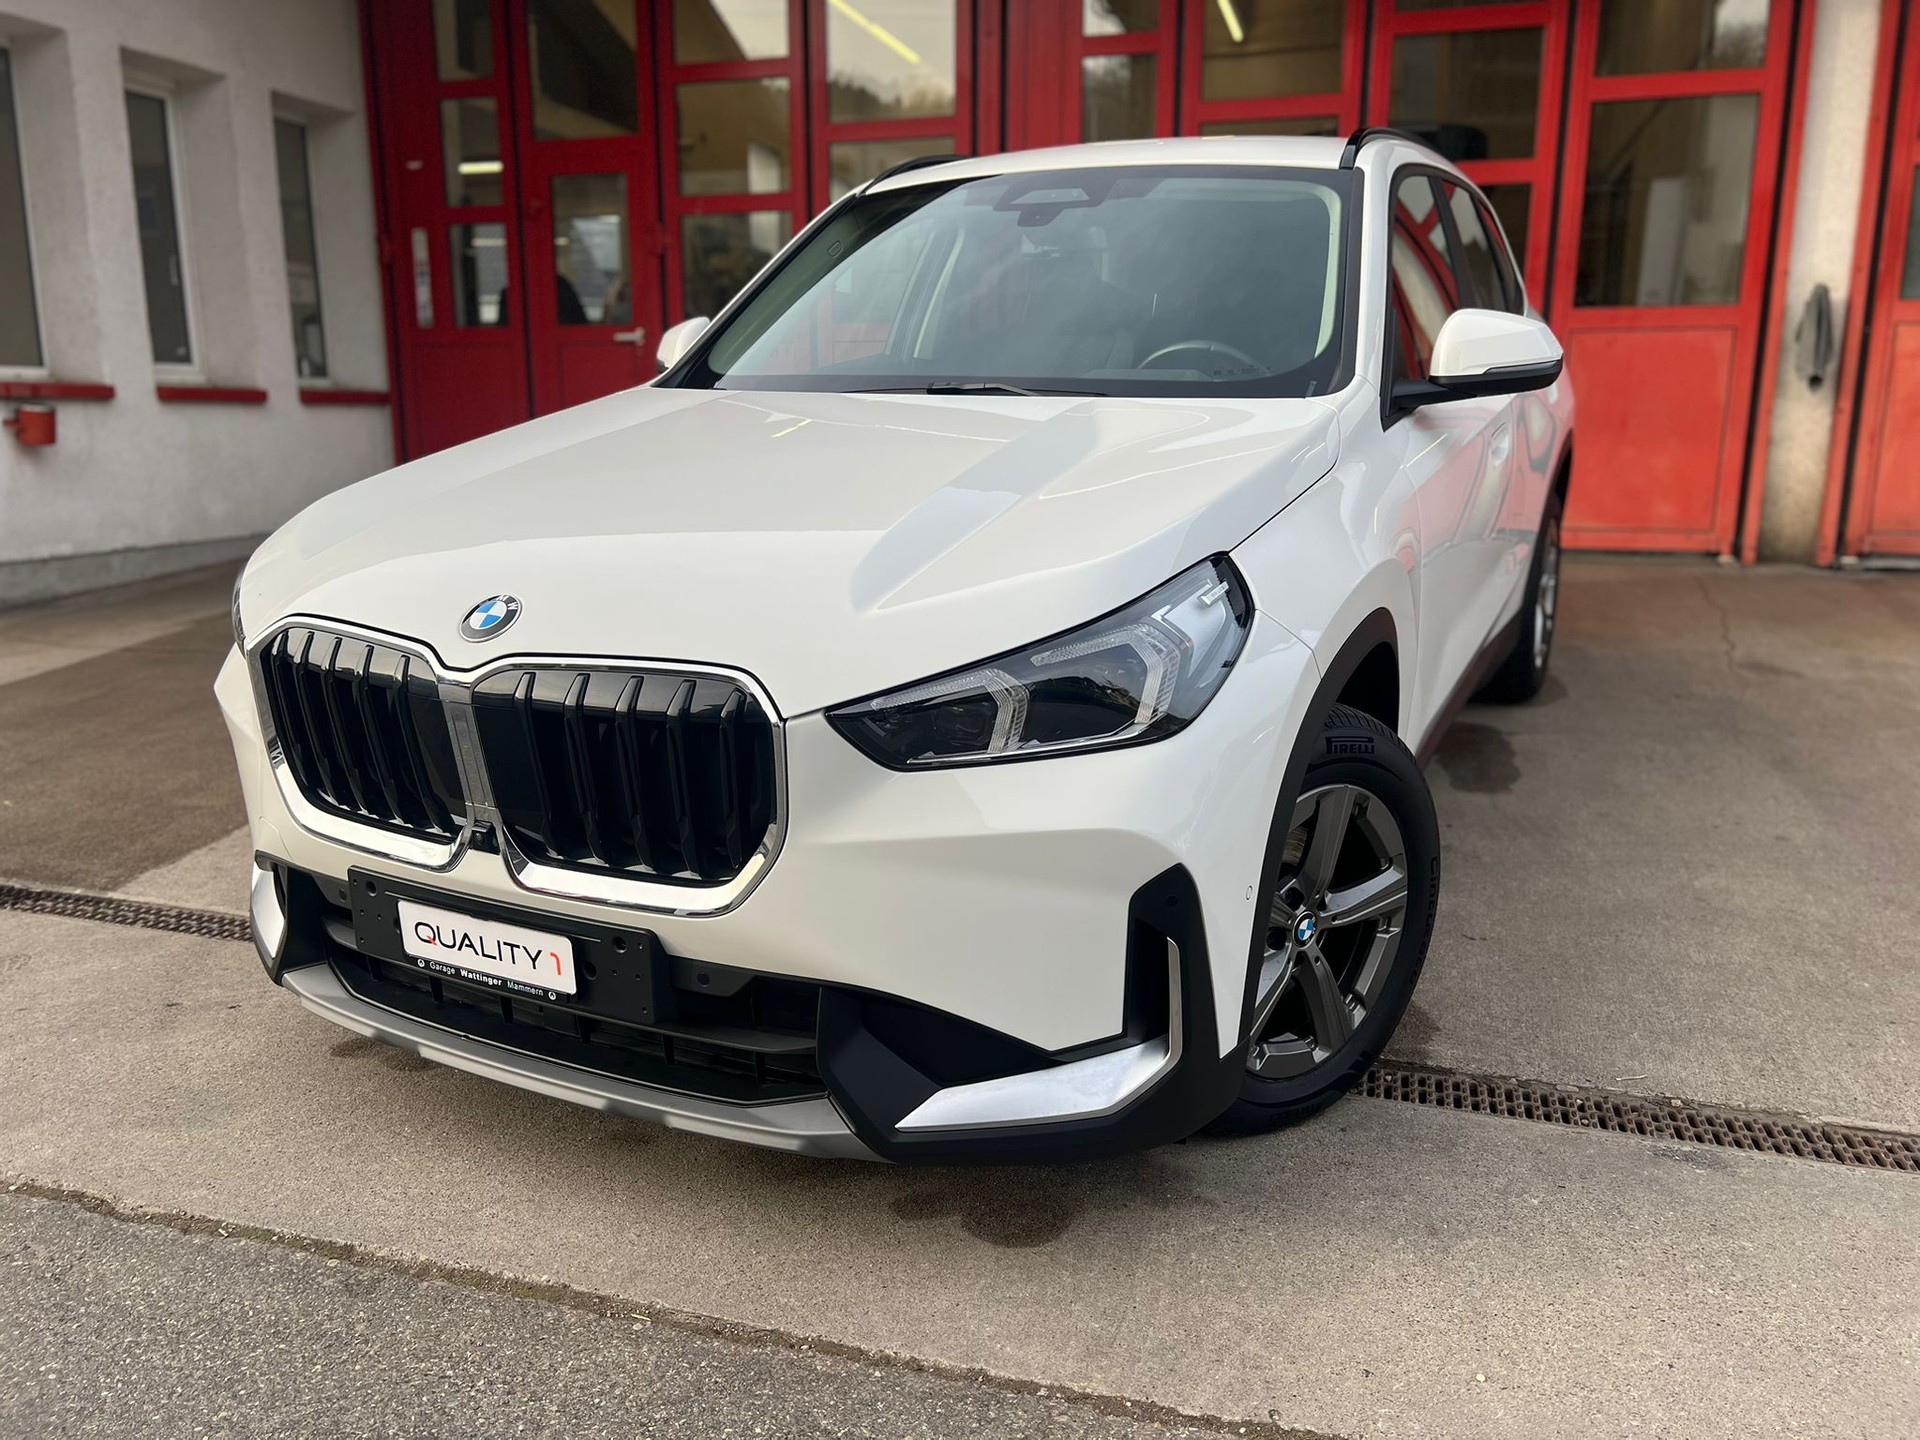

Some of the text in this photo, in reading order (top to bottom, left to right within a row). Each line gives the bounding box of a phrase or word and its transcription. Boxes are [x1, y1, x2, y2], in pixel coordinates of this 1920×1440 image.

[1325, 735, 1375, 755] PIRELLI
[414, 921, 562, 976] QUALITY 1
[429, 961, 544, 996] Garage Wattinger Mammern
